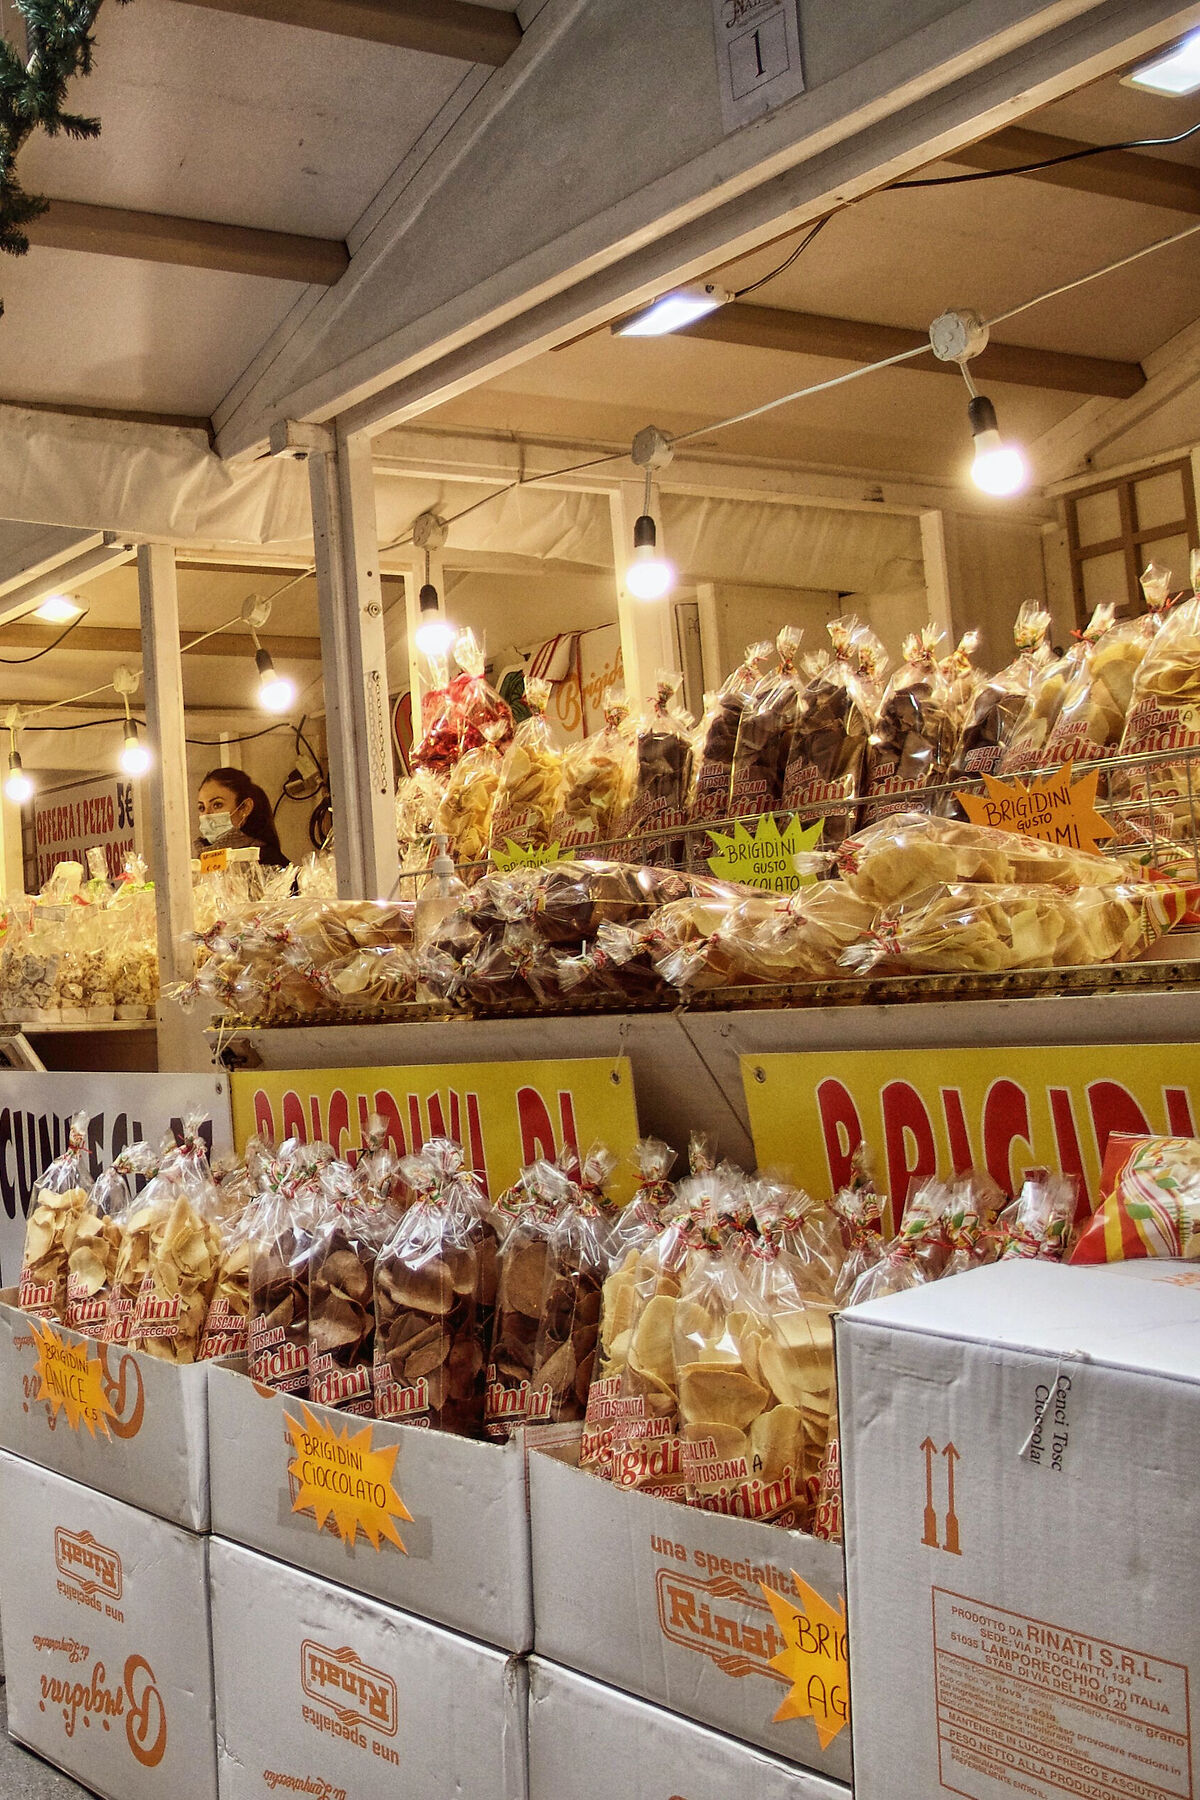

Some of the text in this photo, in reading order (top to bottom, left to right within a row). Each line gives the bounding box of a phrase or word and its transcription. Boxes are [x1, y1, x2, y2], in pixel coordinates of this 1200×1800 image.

[750, 29, 767, 78] 1
[36, 803, 76, 846] OFFERTA
[83, 794, 115, 836] PEZZO
[983, 785, 1072, 827] BRIGIDINI
[1016, 812, 1052, 832] GUSTO
[725, 837, 796, 864] BRIGIDINI
[753, 859, 787, 874] GUSTO
[43, 1342, 89, 1376] BRIGIDINI
[45, 1361, 88, 1404] ANICE
[1051, 1375, 1072, 1473] Cenci Tosc
[300, 1433, 363, 1472] BRIGIDINI
[696, 1457, 749, 1484] TOSCANA
[752, 1453, 764, 1473] A
[302, 1460, 387, 1509] CIOCCOLATO
[59, 1537, 118, 1590] Rinati
[650, 1534, 688, 1563] una
[56, 1578, 125, 1624] una specialità
[951, 1605, 1162, 1683] PRODOTTO DA RINATI S.R.L.
[979, 1628, 1132, 1686] SEDE: VIA P. TOGLIATTI, 134
[308, 1652, 390, 1723] Rinati
[950, 1631, 1171, 1715] 51035 LAMPORECCHIO (PT) ITALIA
[985, 1654, 1127, 1712] STAB. DI VIA DEL PINO, 20
[39, 1653, 167, 1768] Brigidini
[301, 1703, 400, 1766] una specialità
[948, 1711, 1005, 1740] MANTENERE
[1006, 1734, 1016, 1745] IN
[1019, 1740, 1054, 1760] LUOGO
[1057, 1755, 1099, 1777] FRESCO
[1101, 1772, 1109, 1780] E
[1111, 1776, 1168, 1800] ASCIUTTO
[1077, 1732, 1126, 1757] provocare
[1171, 1766, 1181, 1776] in
[1145, 1727, 1186, 1748] grano
[949, 1729, 977, 1747] PESO
[979, 1742, 1015, 1763] NETTO
[1018, 1758, 1047, 1777] ALLA
[1050, 1770, 1124, 1800] PRODUZION
